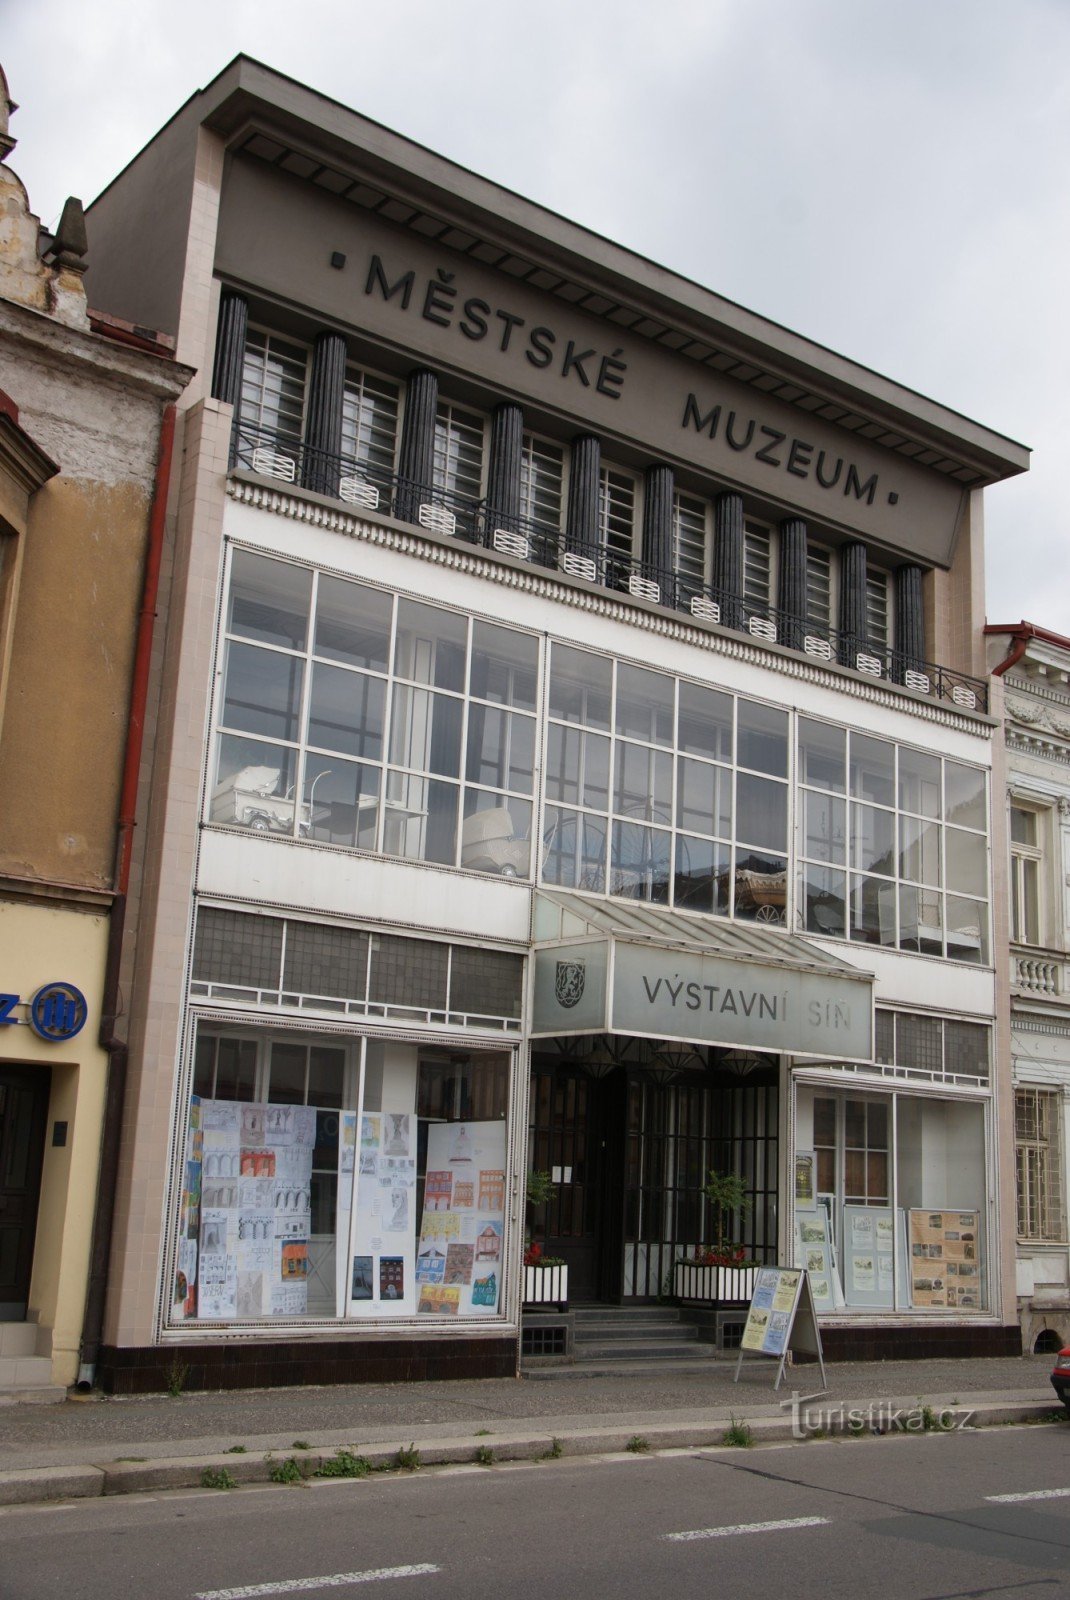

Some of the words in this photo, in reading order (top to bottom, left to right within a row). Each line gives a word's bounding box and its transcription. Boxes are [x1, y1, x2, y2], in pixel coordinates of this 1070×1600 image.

[365, 254, 627, 399] MĚSTSKÉ
[682, 393, 879, 505] MUZEUM
[642, 974, 789, 1022] VÝSTAVNÍ
